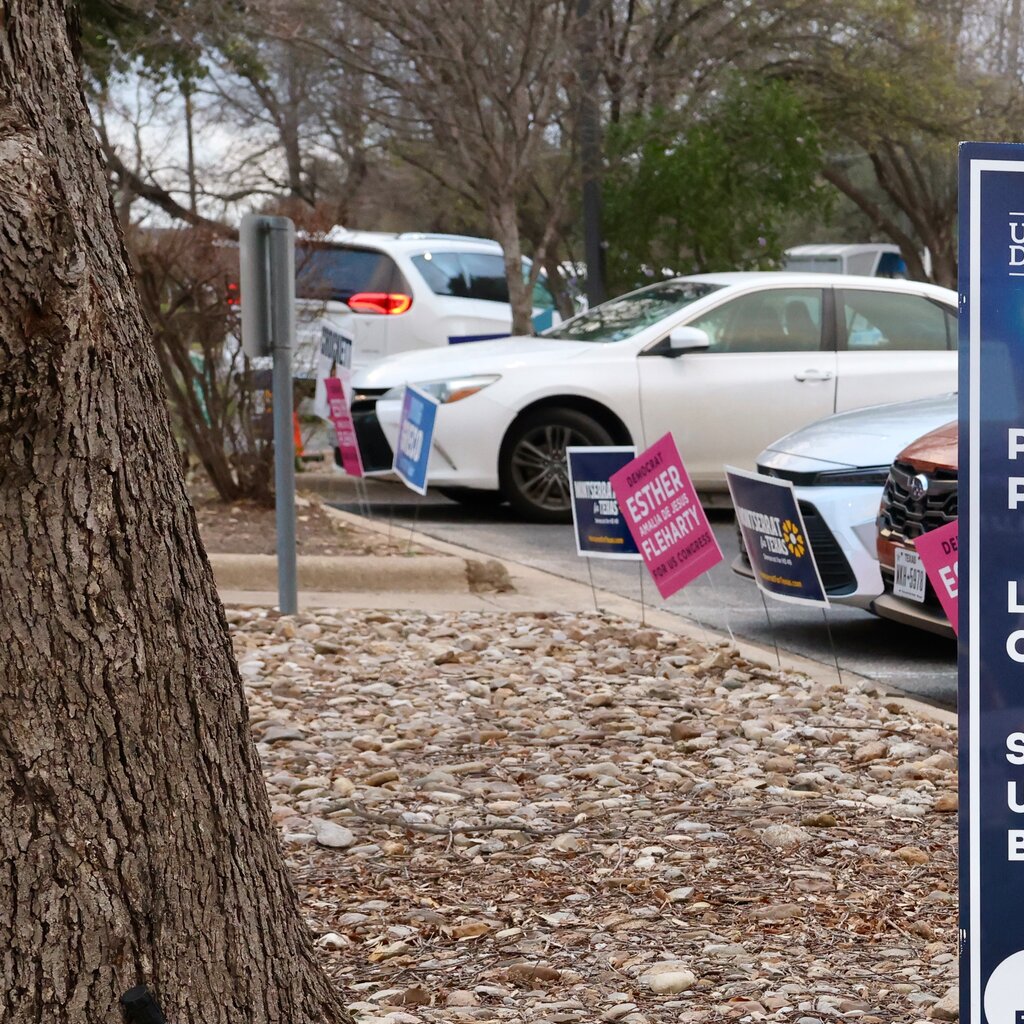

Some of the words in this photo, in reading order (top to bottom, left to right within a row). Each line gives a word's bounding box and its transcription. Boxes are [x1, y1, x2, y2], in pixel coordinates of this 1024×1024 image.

[626, 452, 664, 488] DEMOCRAT
[625, 464, 684, 524] ESTHER
[638, 513, 664, 537] AMALIA
[662, 505, 672, 520] DE
[671, 493, 690, 514] JESUS
[641, 505, 701, 562] FLEHARTY
[652, 563, 668, 579] FOR
[668, 556, 679, 570] US
[677, 532, 712, 564] CONGRESS
[941, 535, 958, 555] DE
